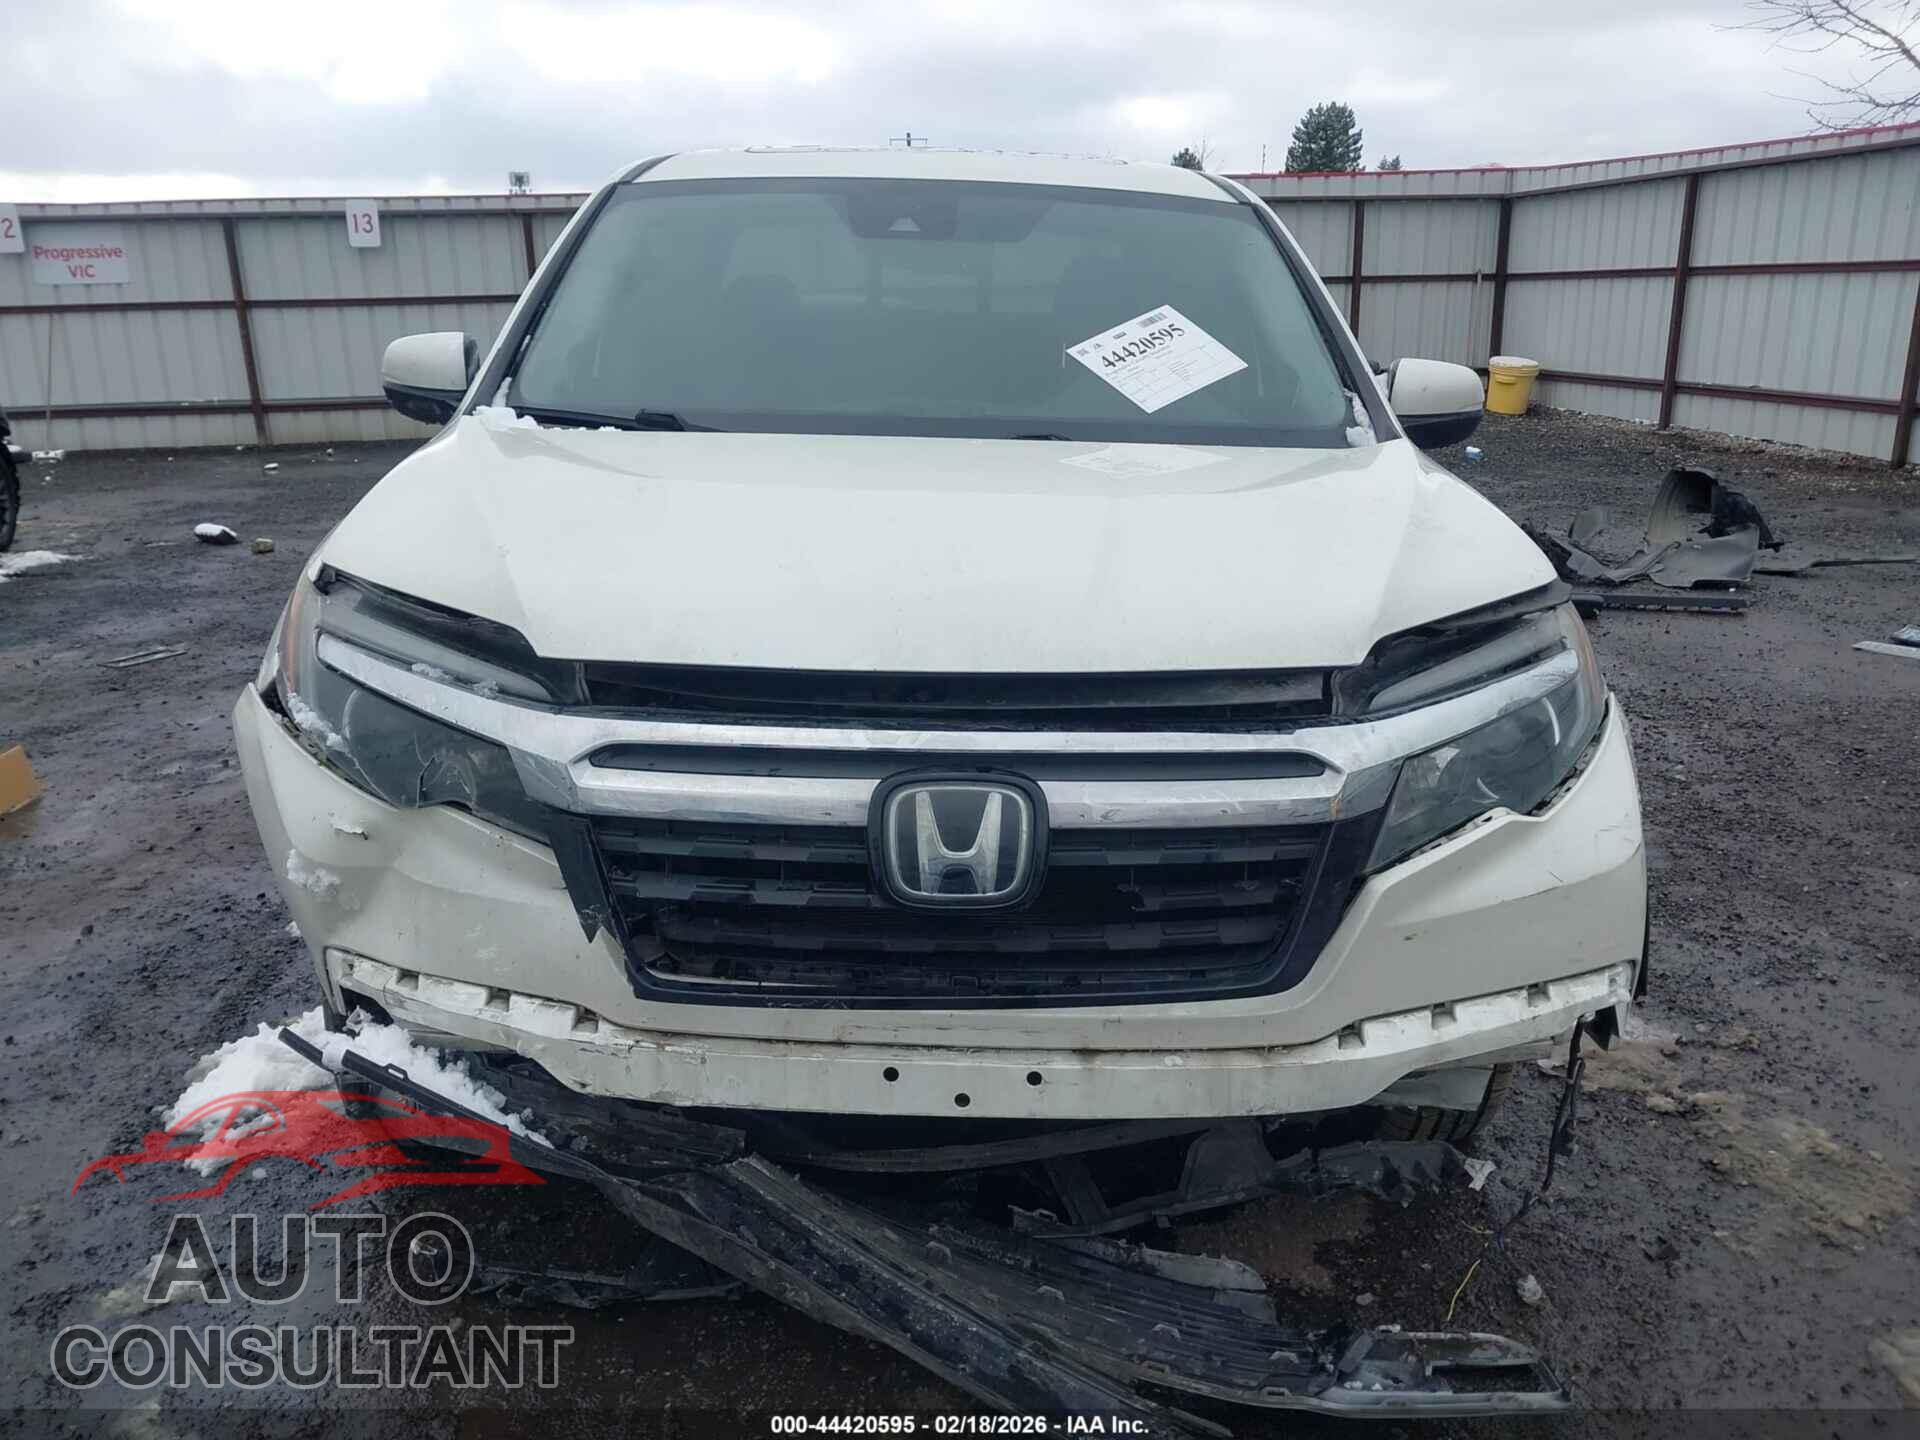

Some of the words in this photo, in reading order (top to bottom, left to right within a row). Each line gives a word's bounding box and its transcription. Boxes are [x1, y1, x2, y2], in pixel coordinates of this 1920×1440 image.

[352, 212, 374, 234] 13
[32, 245, 122, 262] Progressive
[67, 264, 96, 279] VIC
[1101, 323, 1185, 368] 44420595
